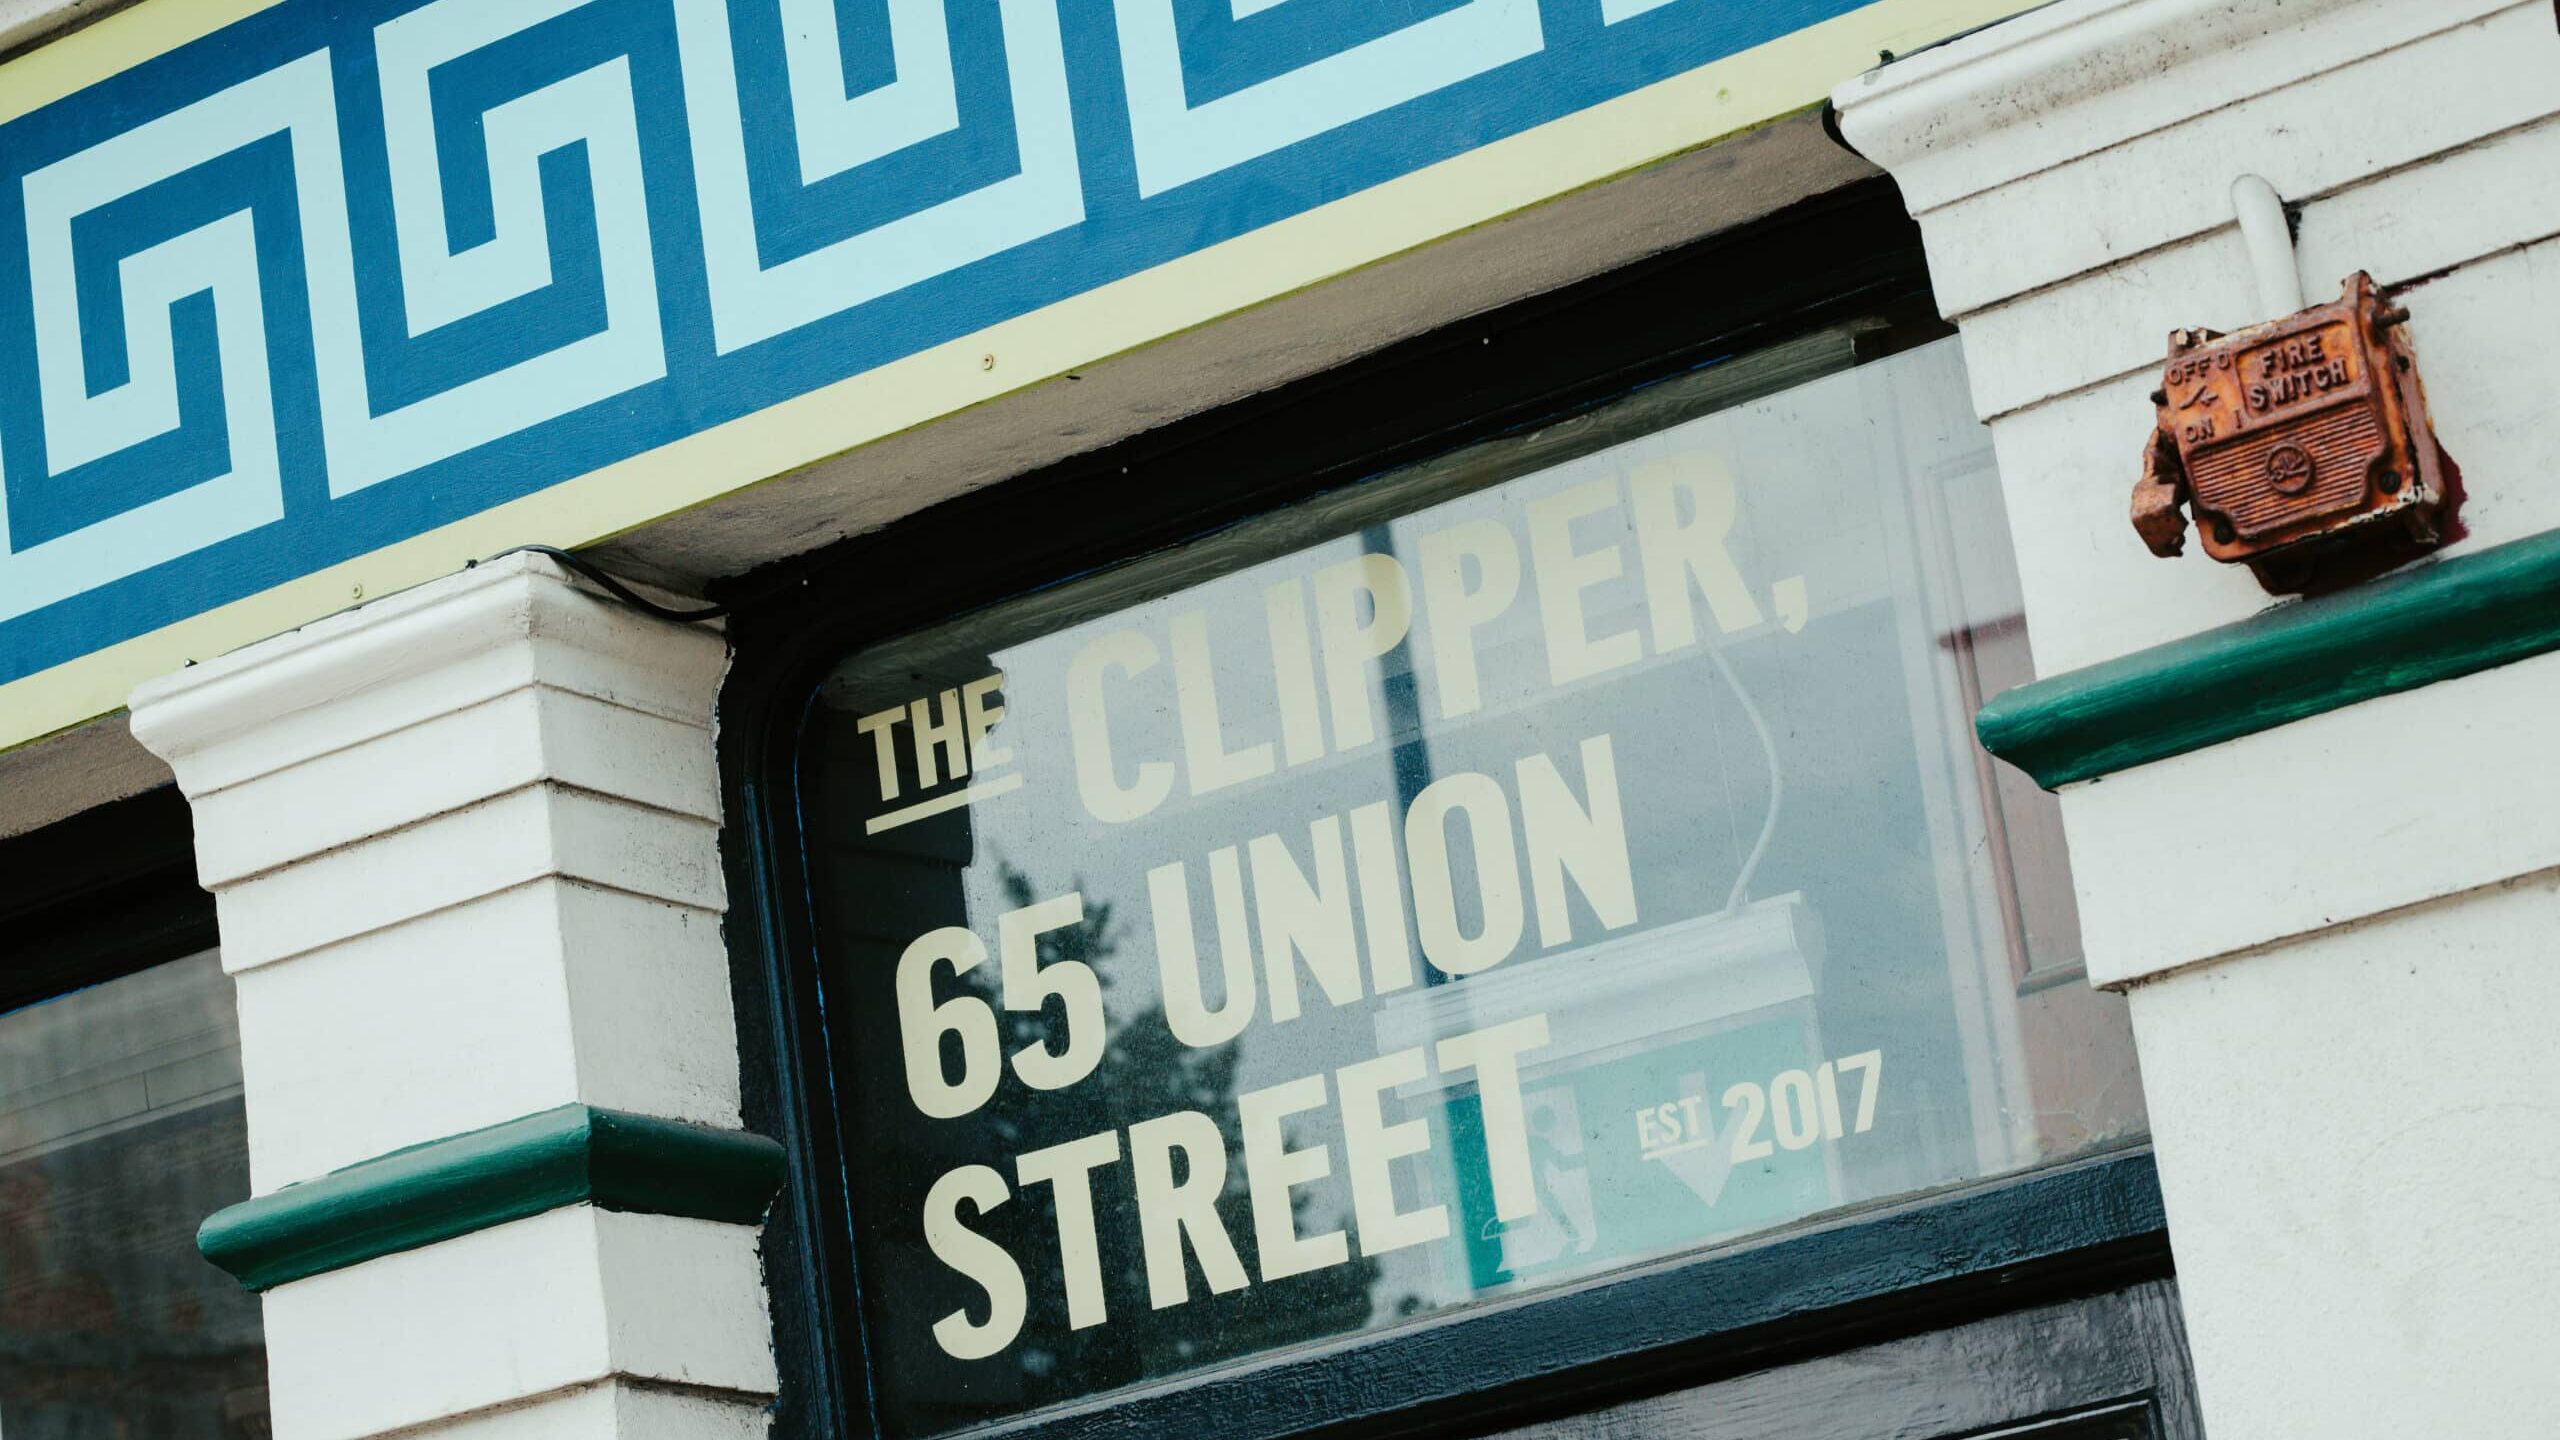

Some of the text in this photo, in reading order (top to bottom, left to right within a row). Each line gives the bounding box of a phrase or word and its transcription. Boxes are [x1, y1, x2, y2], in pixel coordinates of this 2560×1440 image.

[2168, 356, 2211, 386] OFF
[2250, 357, 2350, 411] SWITCH
[2261, 334, 2325, 378] FIRE
[2185, 417, 2214, 442] ON
[857, 450, 1808, 823] THE CLIPPER,
[896, 733, 1638, 1119] 65 UNION
[1635, 1049, 1882, 1164] EST 2017
[923, 1013, 1551, 1360] STREET
